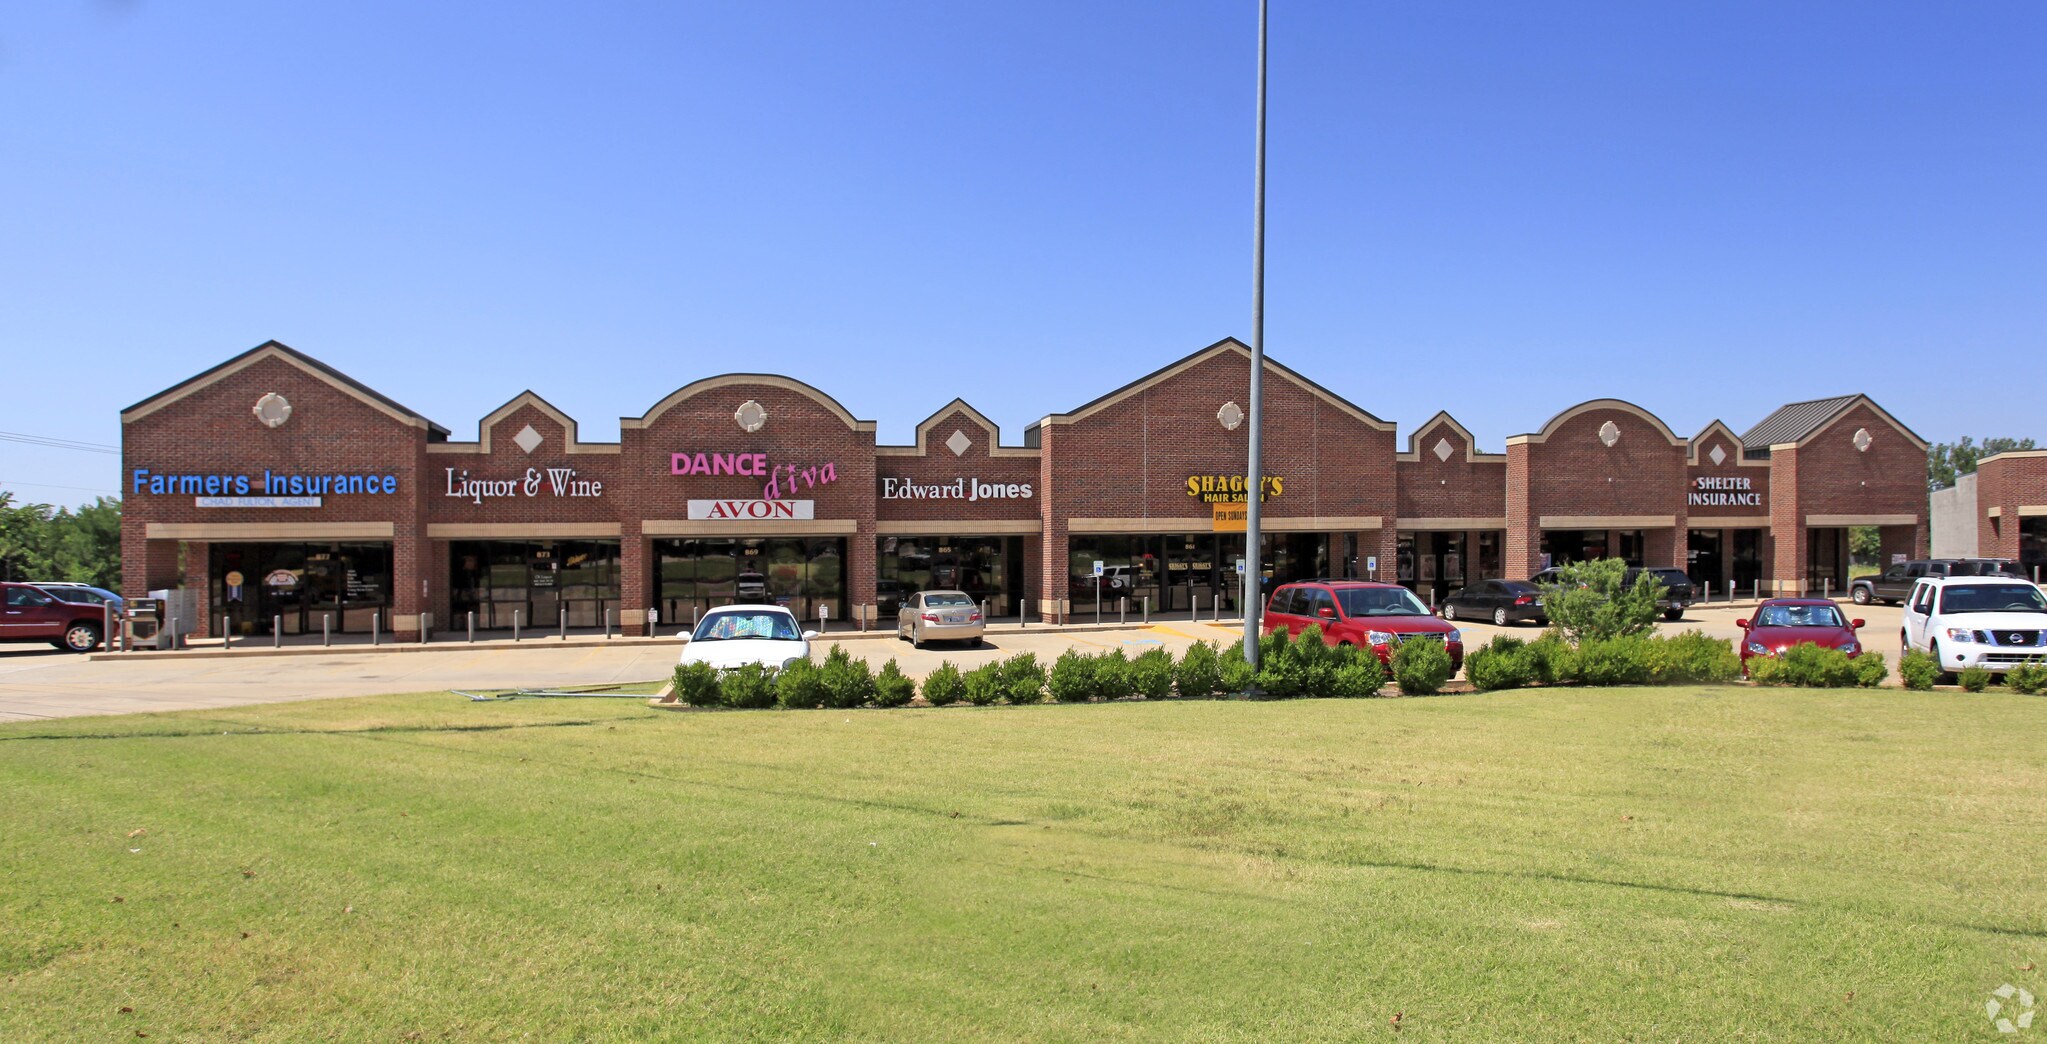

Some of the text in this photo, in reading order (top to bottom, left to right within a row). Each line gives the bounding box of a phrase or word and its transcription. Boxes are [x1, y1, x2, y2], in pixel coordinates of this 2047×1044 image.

[671, 453, 766, 476] DANCE
[133, 469, 398, 495] Farmers Insurance
[445, 468, 602, 504] Liquor & Wine
[764, 462, 837, 501] diva
[882, 477, 1033, 501] Edward Jones
[1696, 476, 1751, 490] SHELTER
[201, 498, 233, 506] CHAD
[282, 498, 315, 506] AGENT
[1204, 493, 1265, 503] HAIR SAL
[1688, 492, 1762, 506] INSURANCE
[706, 501, 797, 519] AVON
[1215, 511, 1227, 521] OPEN
